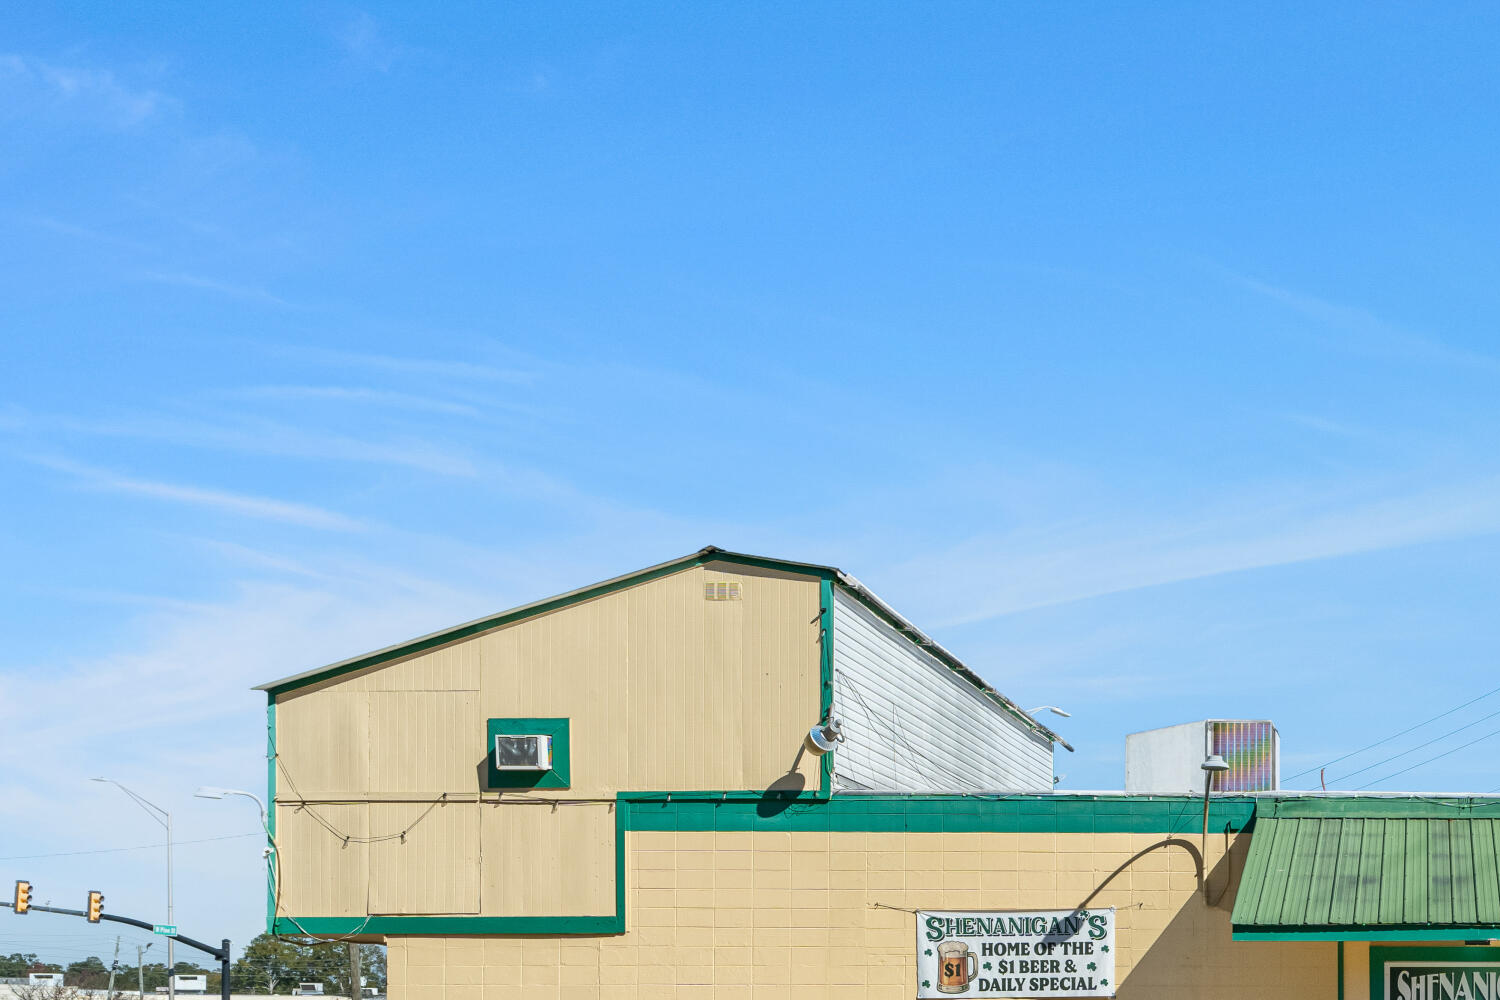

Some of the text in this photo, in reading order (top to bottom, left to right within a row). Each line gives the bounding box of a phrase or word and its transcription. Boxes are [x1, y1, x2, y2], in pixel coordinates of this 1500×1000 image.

[981, 942, 1094, 957] HOME OF THE
[944, 963, 961, 978] $1
[998, 959, 1077, 975] $1 BEER &
[978, 977, 1097, 992] DAILY SPECIAL
